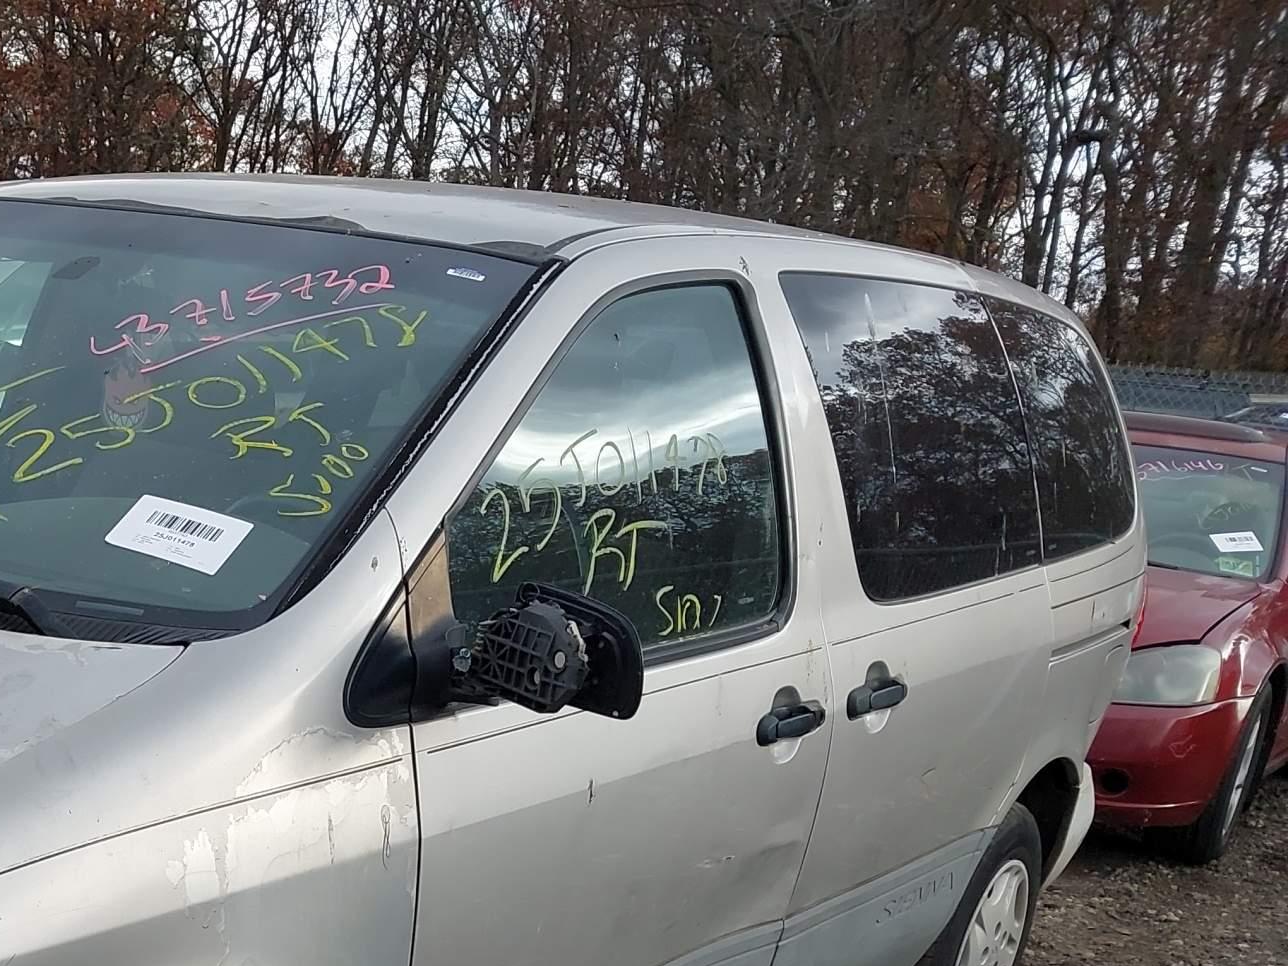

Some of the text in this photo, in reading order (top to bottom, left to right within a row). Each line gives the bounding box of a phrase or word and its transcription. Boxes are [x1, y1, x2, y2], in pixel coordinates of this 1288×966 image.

[90, 265, 395, 364] 43715732
[209, 401, 332, 460] RT
[153, 531, 196, 548] 25J011478
[583, 508, 667, 597] RT
